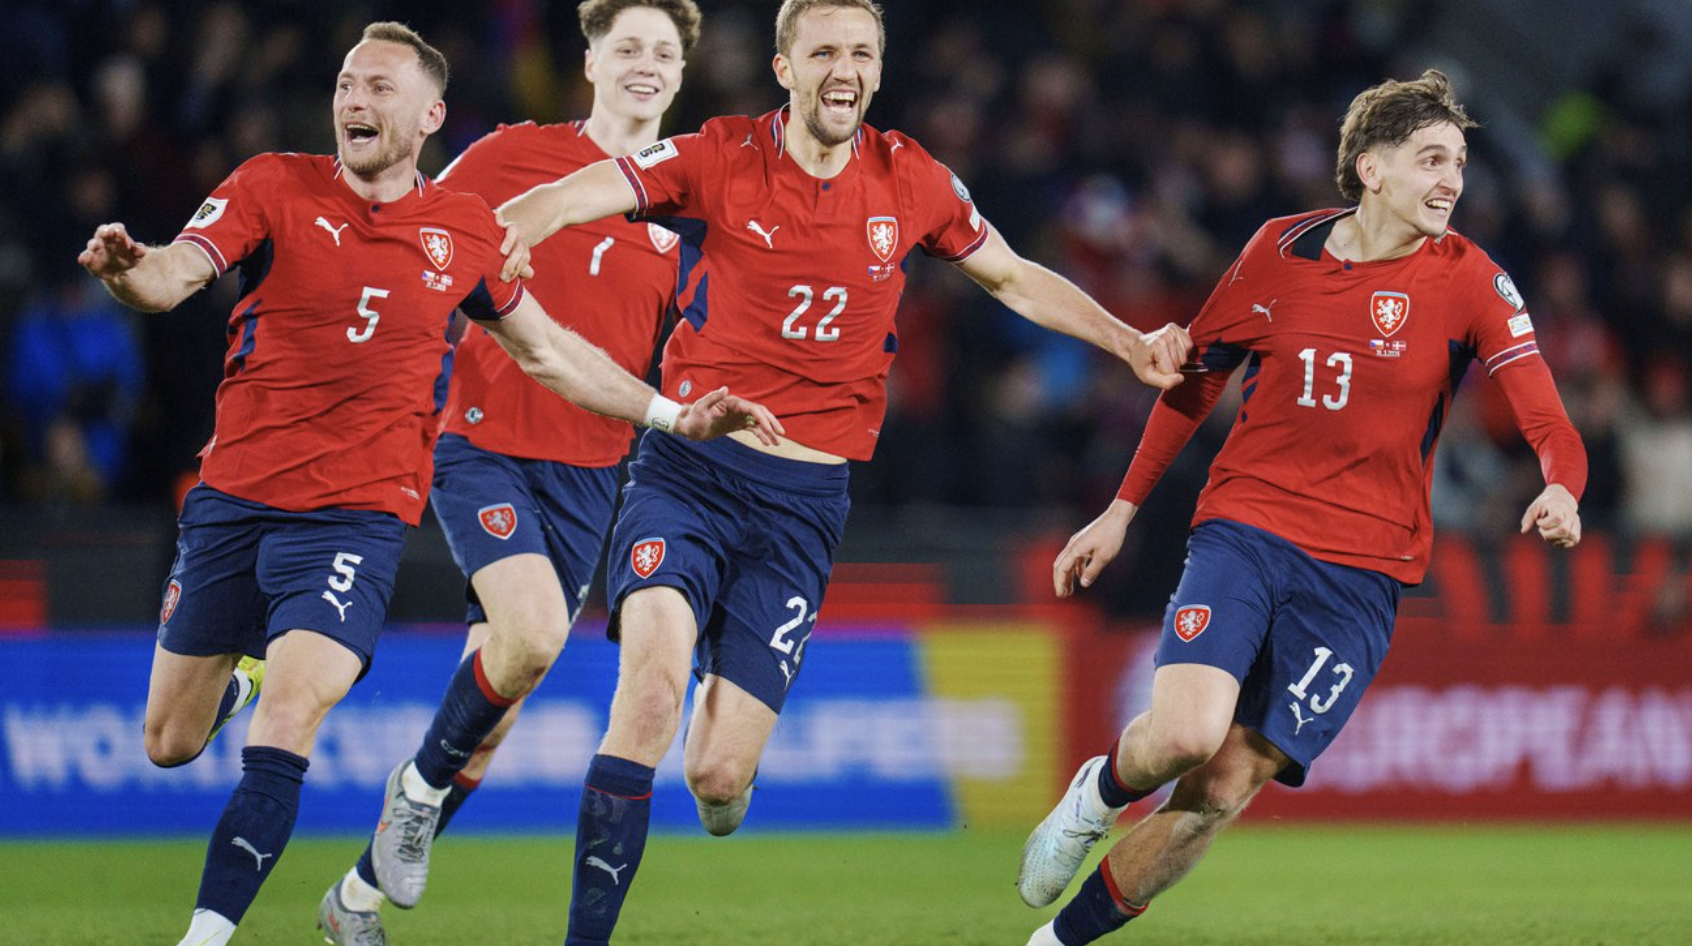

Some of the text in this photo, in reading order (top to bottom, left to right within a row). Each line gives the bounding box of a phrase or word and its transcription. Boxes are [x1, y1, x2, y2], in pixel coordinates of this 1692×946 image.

[346, 286, 390, 343] 5
[781, 285, 848, 341] 22
[1297, 348, 1353, 411] 13
[328, 552, 364, 593] 5
[1287, 646, 1354, 714] 13
